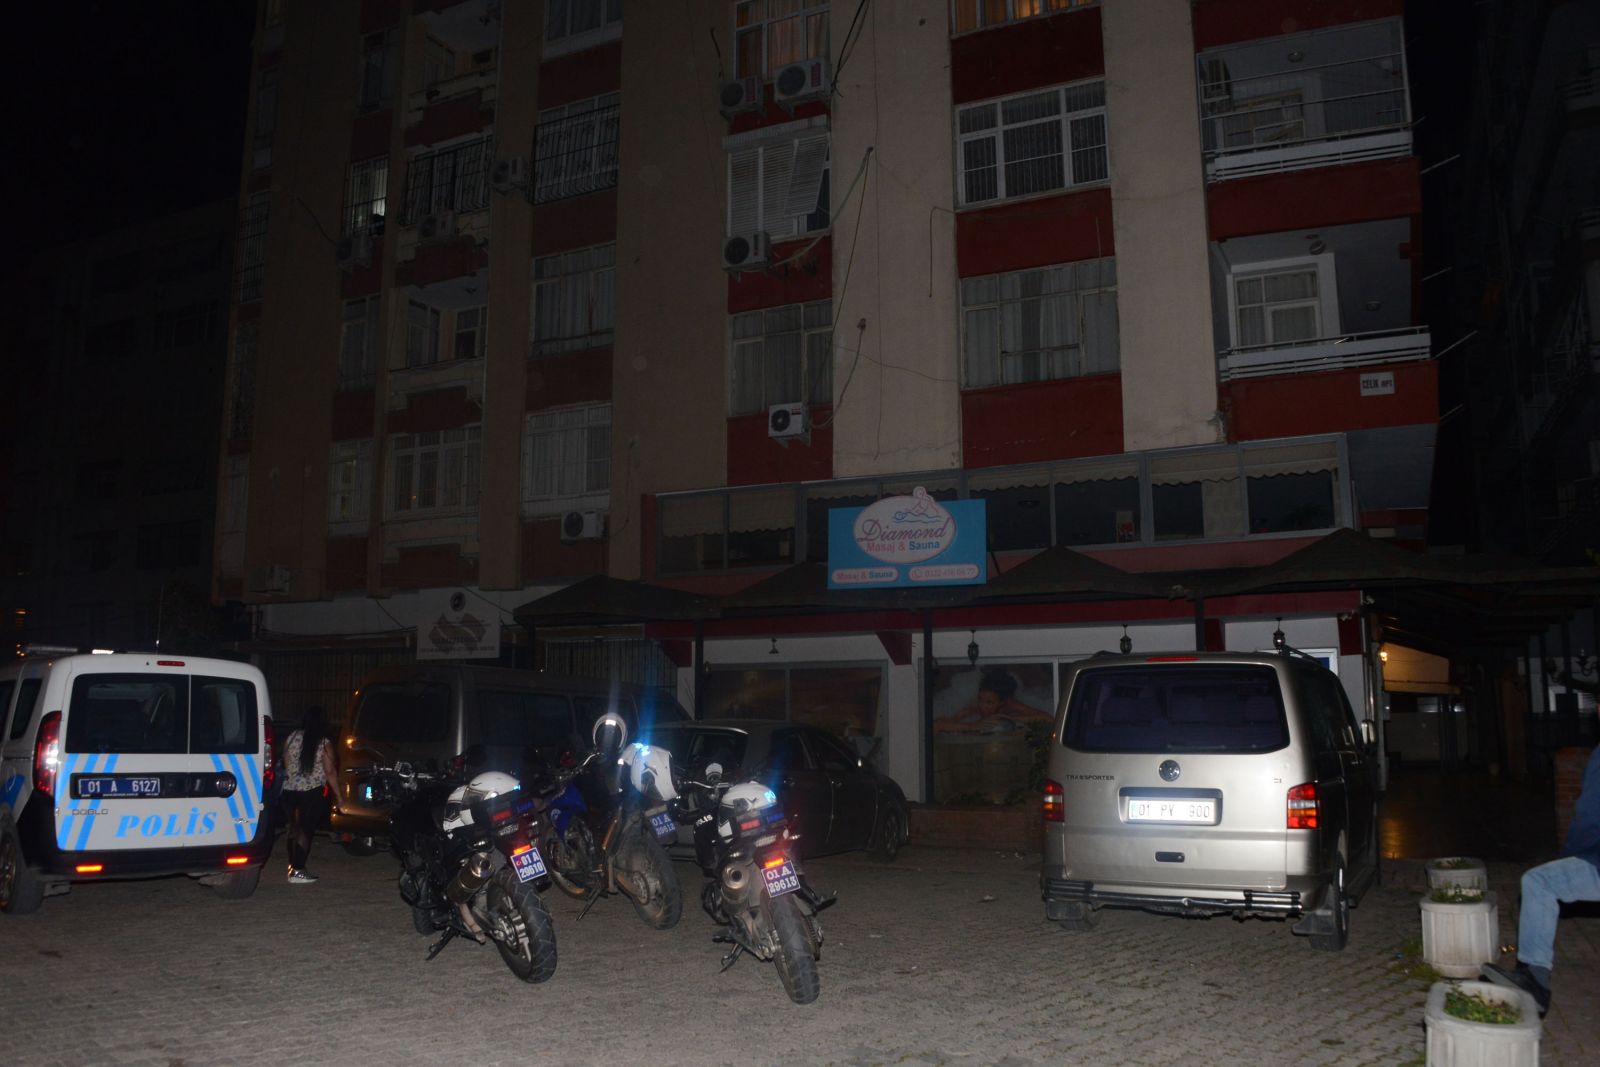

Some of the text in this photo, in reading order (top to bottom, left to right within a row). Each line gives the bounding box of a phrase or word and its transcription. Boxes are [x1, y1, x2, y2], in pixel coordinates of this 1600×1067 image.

[857, 517, 951, 542] Diamond
[866, 540, 940, 553] Masaj & Sauna
[868, 570, 893, 579] Sauna
[88, 780, 158, 793] 01 A 6127
[72, 808, 109, 816] DOBLO
[1139, 804, 1150, 816] 01
[1161, 804, 1174, 816] PV
[114, 807, 218, 838] POLİS
[651, 814, 672, 826] 01 A
[520, 851, 540, 866] 01 A
[519, 861, 543, 879] 29610
[766, 866, 791, 880] 01 A
[768, 876, 797, 894] 29613
